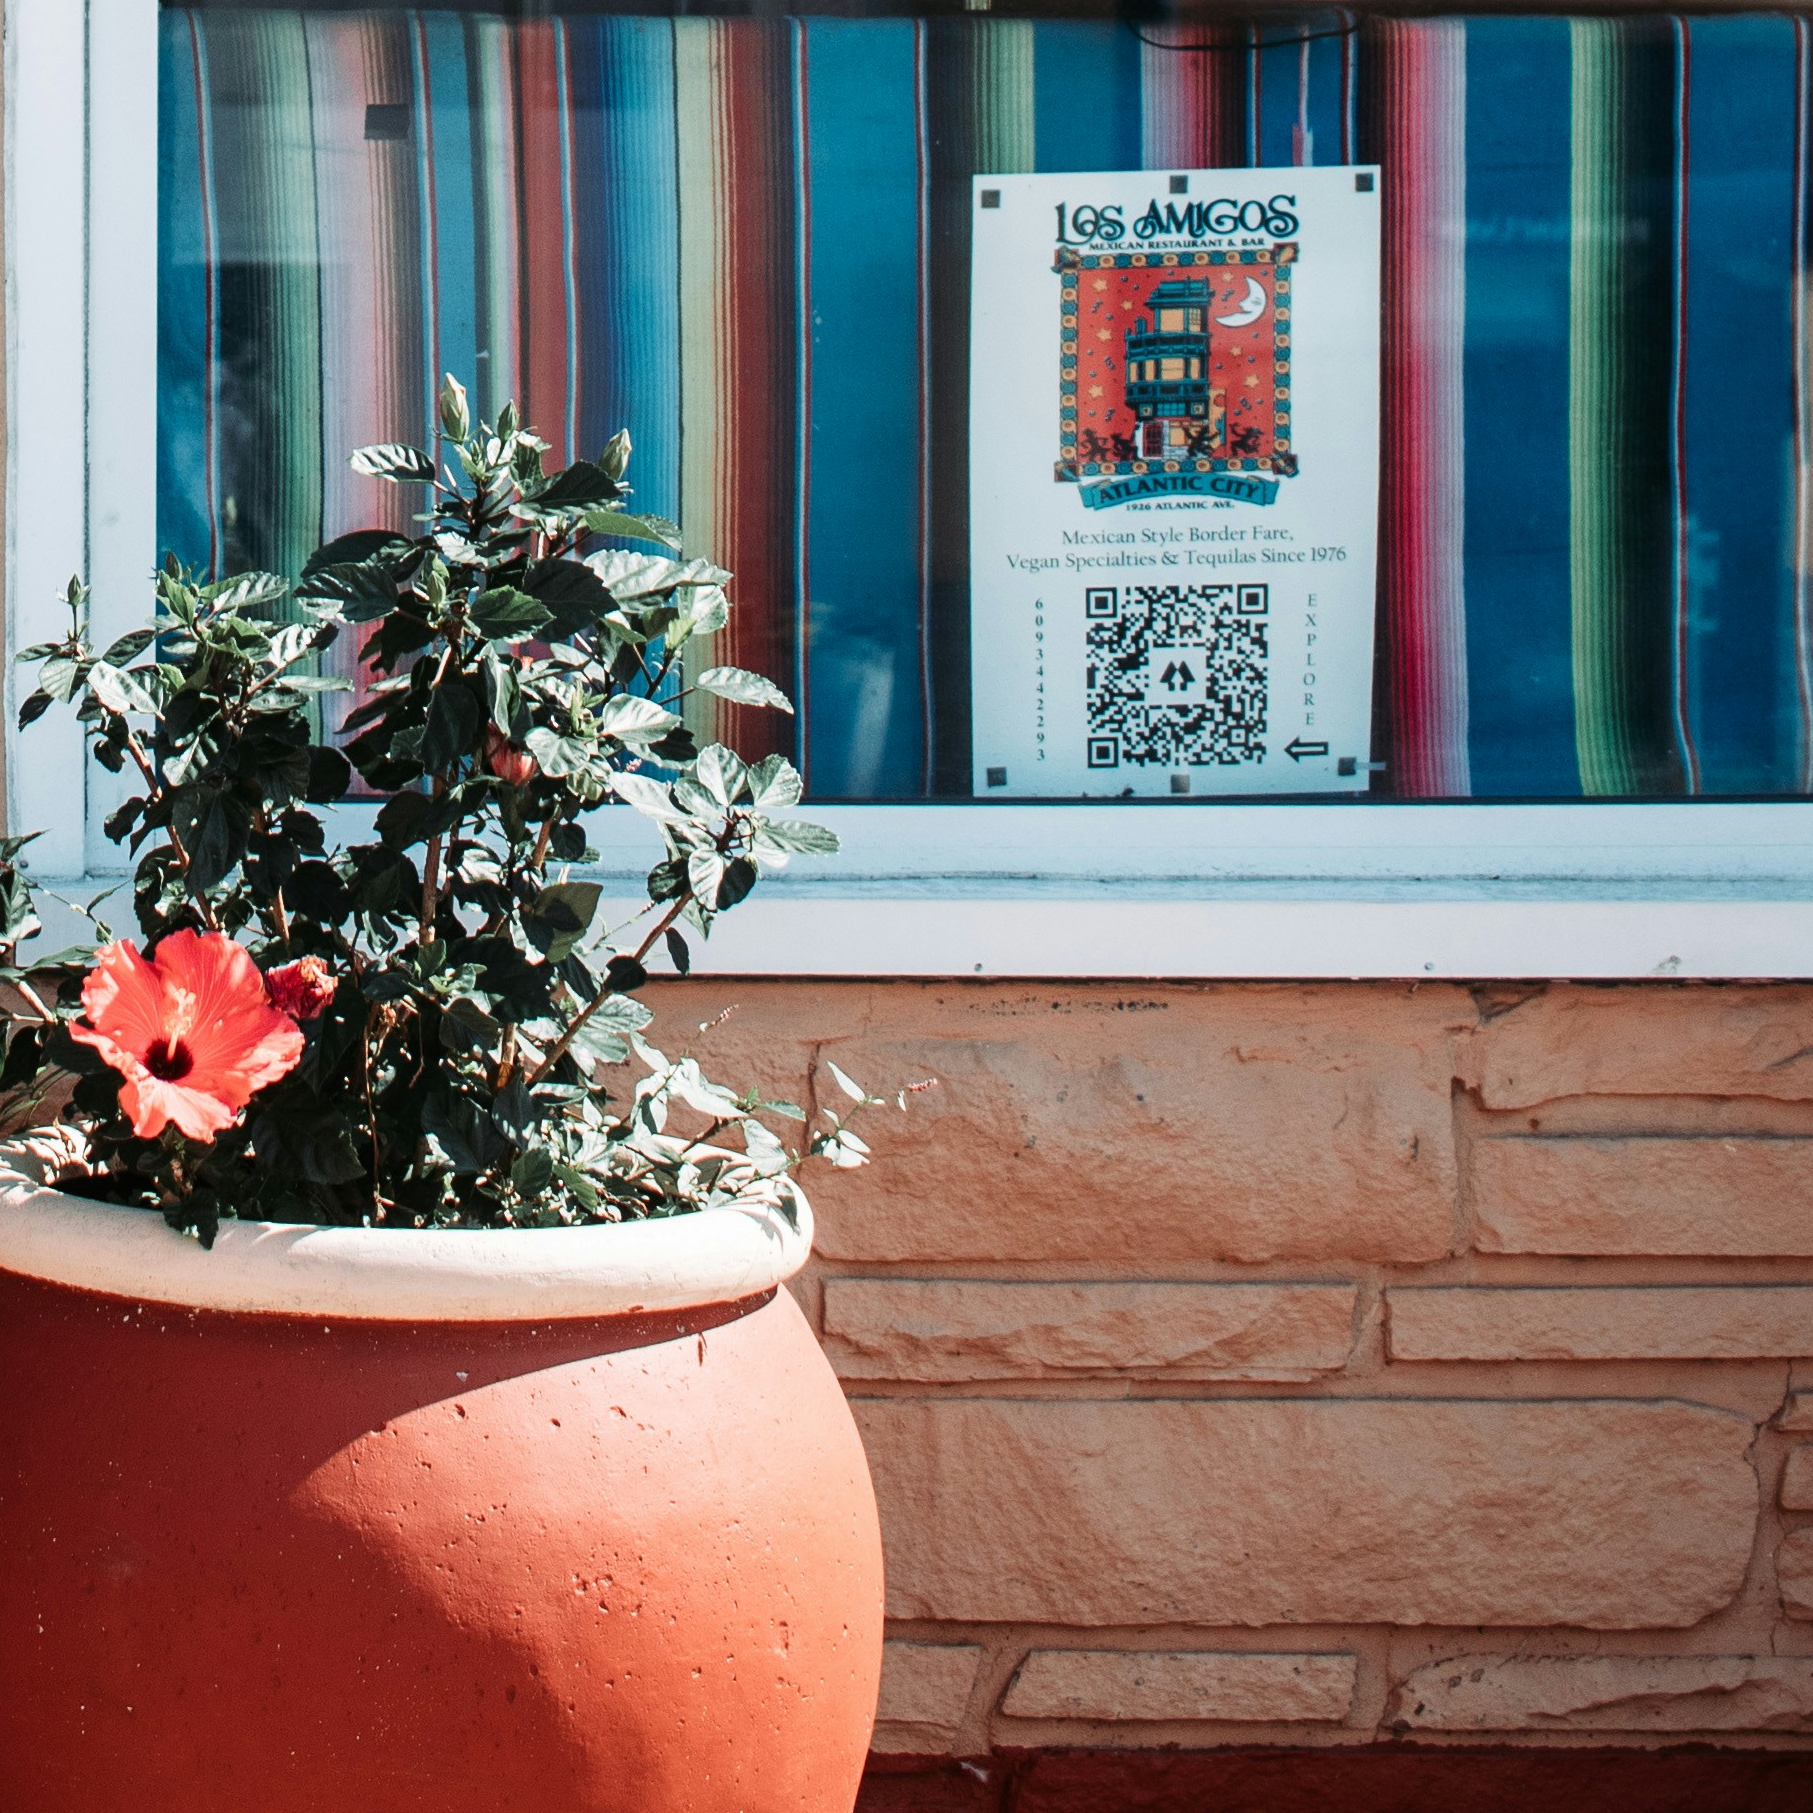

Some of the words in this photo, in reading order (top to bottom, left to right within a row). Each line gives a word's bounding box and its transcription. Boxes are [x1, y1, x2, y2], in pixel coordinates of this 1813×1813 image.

[1054, 200, 1126, 246] LOS
[1133, 194, 1300, 239] AMIGOS
[1088, 240, 1147, 251] MEXICAN
[1147, 238, 1224, 250] RESTAURANT
[1227, 238, 1237, 247] &
[1241, 237, 1266, 247] BAR
[1099, 476, 1203, 504] ATLANTIC
[1210, 478, 1260, 499] CITY
[1154, 501, 1207, 511] ATLANTIC
[1061, 529, 1136, 545] Mexican
[1140, 527, 1184, 547] Style
[1189, 525, 1246, 543] Border
[1252, 525, 1294, 543] Fare,
[1006, 553, 1060, 573] Vegan
[1065, 550, 1157, 572] Specialties
[1160, 550, 1179, 565] &
[1184, 548, 1257, 569] Tequilas
[1260, 547, 1306, 563] Since
[1310, 546, 1347, 562] 1976
